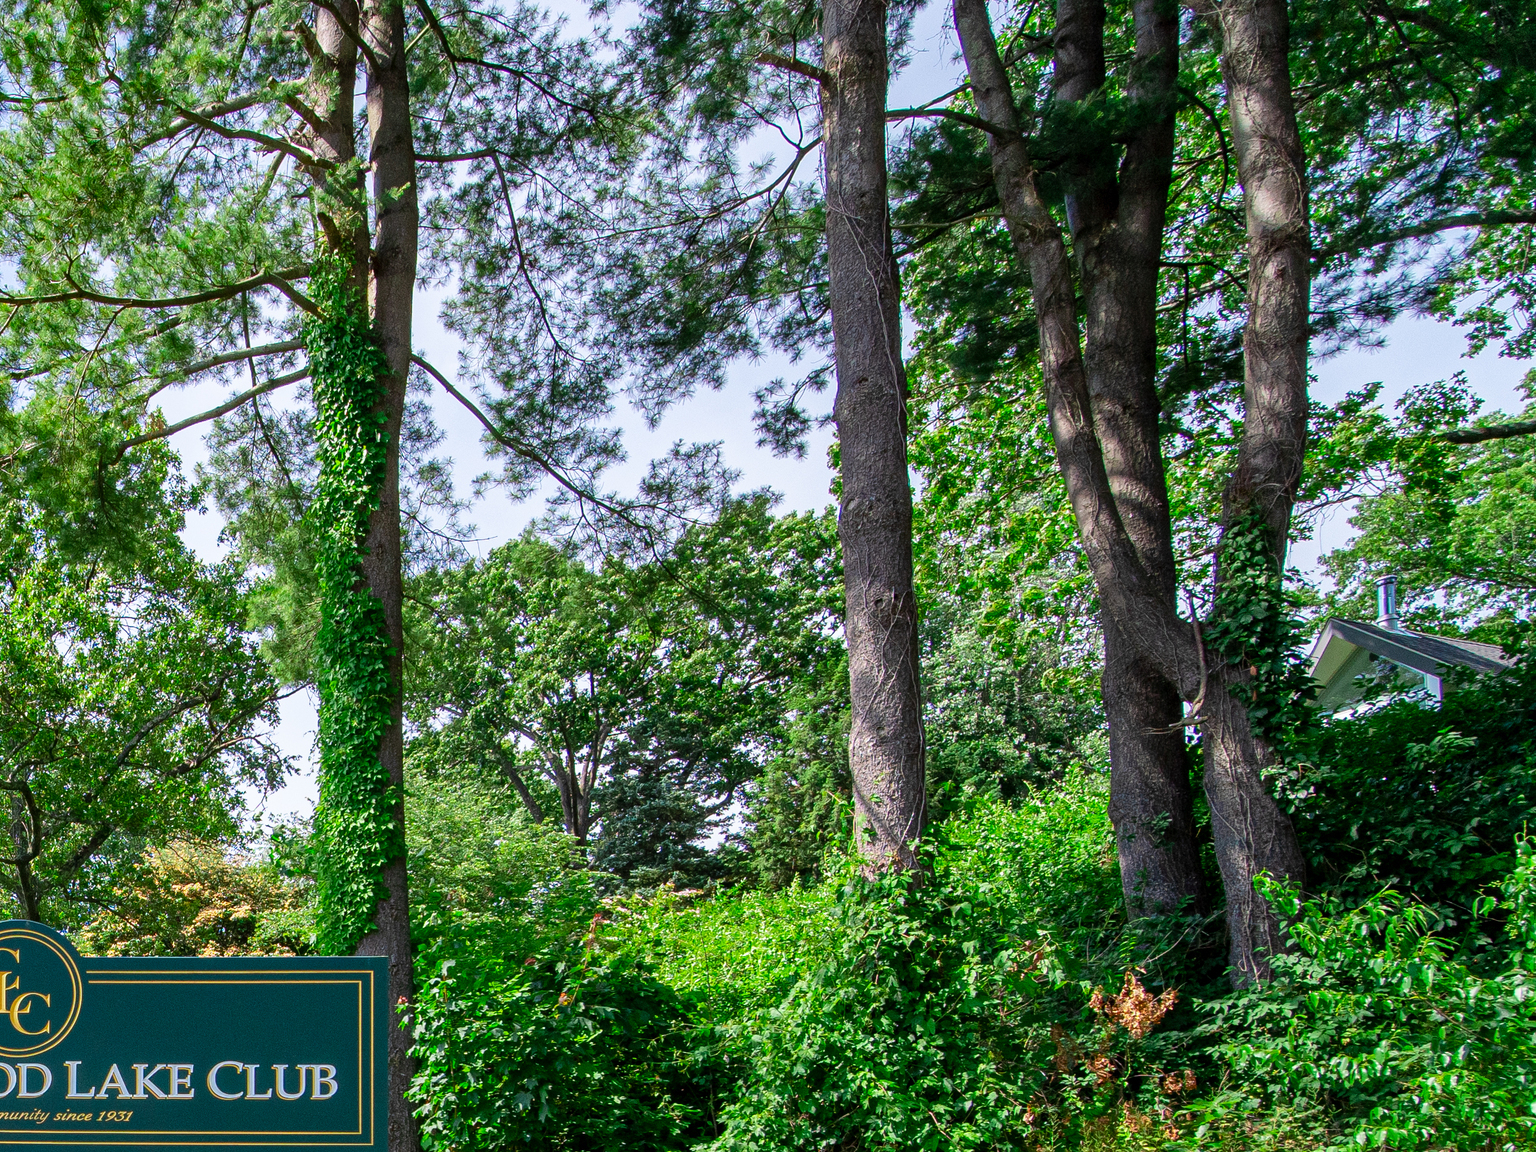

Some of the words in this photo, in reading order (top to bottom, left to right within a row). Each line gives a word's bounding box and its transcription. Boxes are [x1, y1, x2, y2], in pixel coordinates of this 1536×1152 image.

[63, 1060, 196, 1100] LAKE
[206, 1060, 339, 1100] CLUB
[53, 1108, 93, 1122] since
[96, 1110, 134, 1123] 1931
